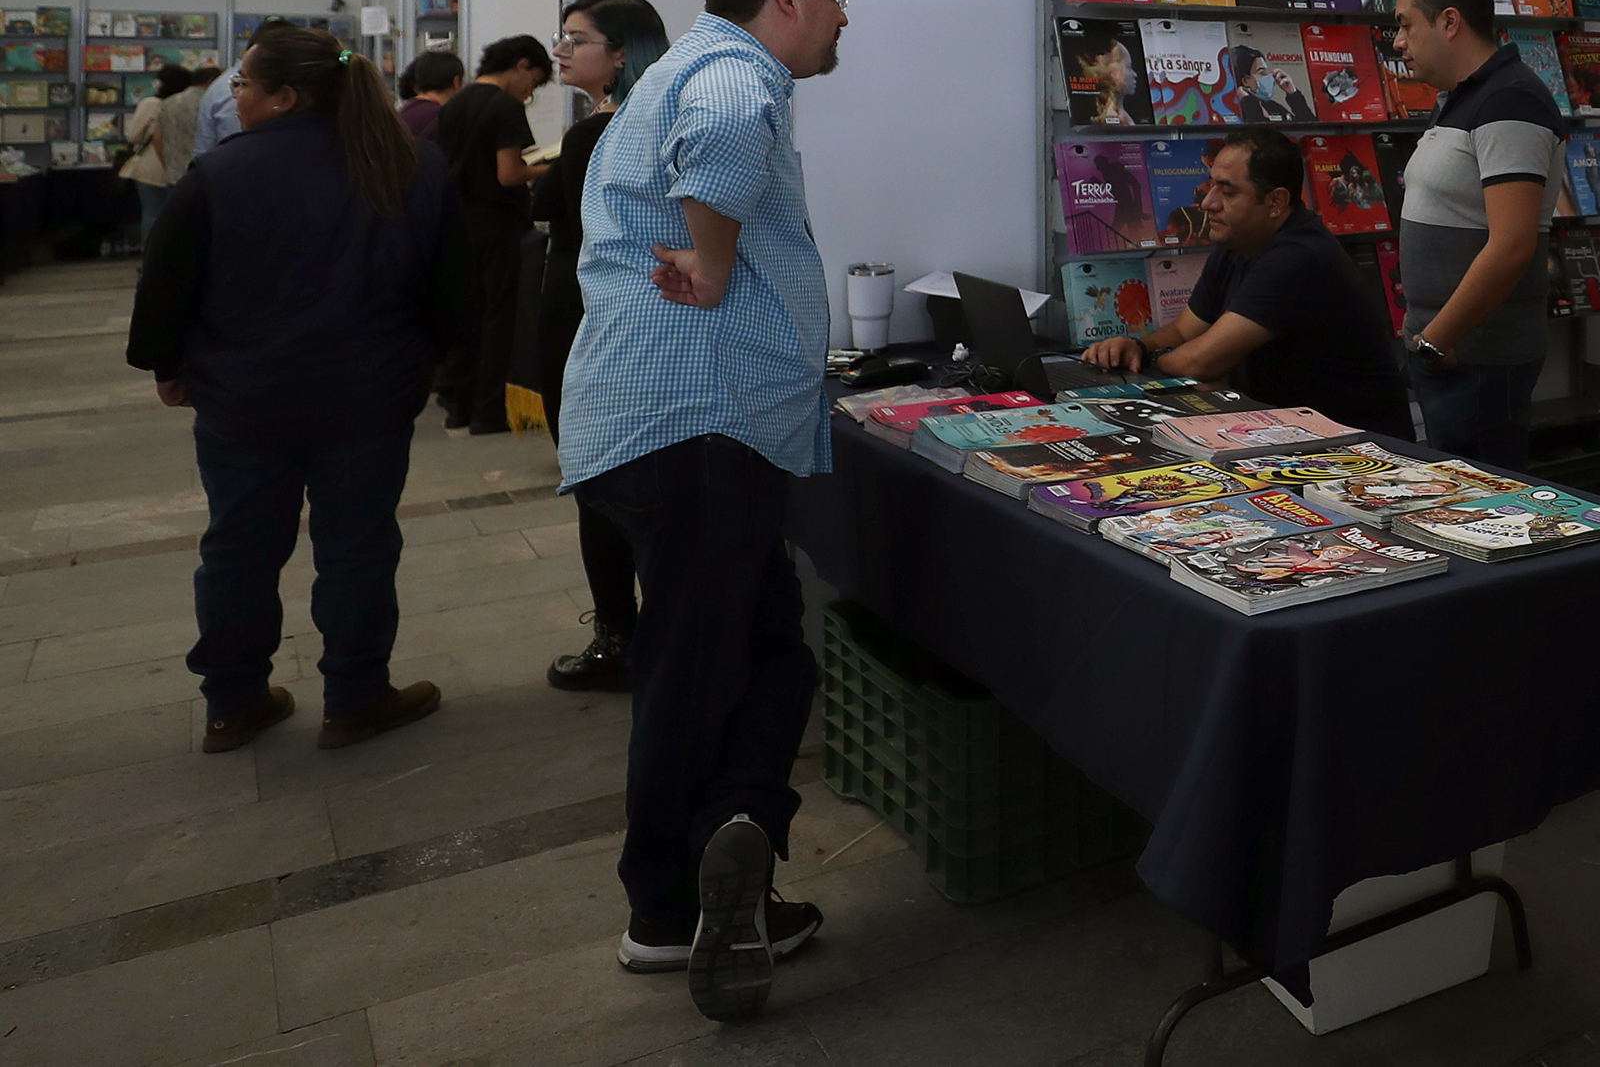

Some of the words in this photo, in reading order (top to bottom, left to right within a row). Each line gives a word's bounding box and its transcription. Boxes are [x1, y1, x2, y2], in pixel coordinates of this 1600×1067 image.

[1266, 51, 1303, 63] ÓMICRON
[1309, 51, 1320, 62] LA
[1319, 52, 1354, 64] PANDEMIA
[1176, 59, 1212, 77] sangre
[1314, 163, 1342, 173] PLANETA
[1573, 157, 1599, 168] AMOR
[1153, 165, 1206, 177] PALEOGENÓMICA
[1071, 180, 1114, 197] TERROR
[1085, 325, 1126, 338] COVID-19
[1457, 524, 1525, 539] FORMAS
